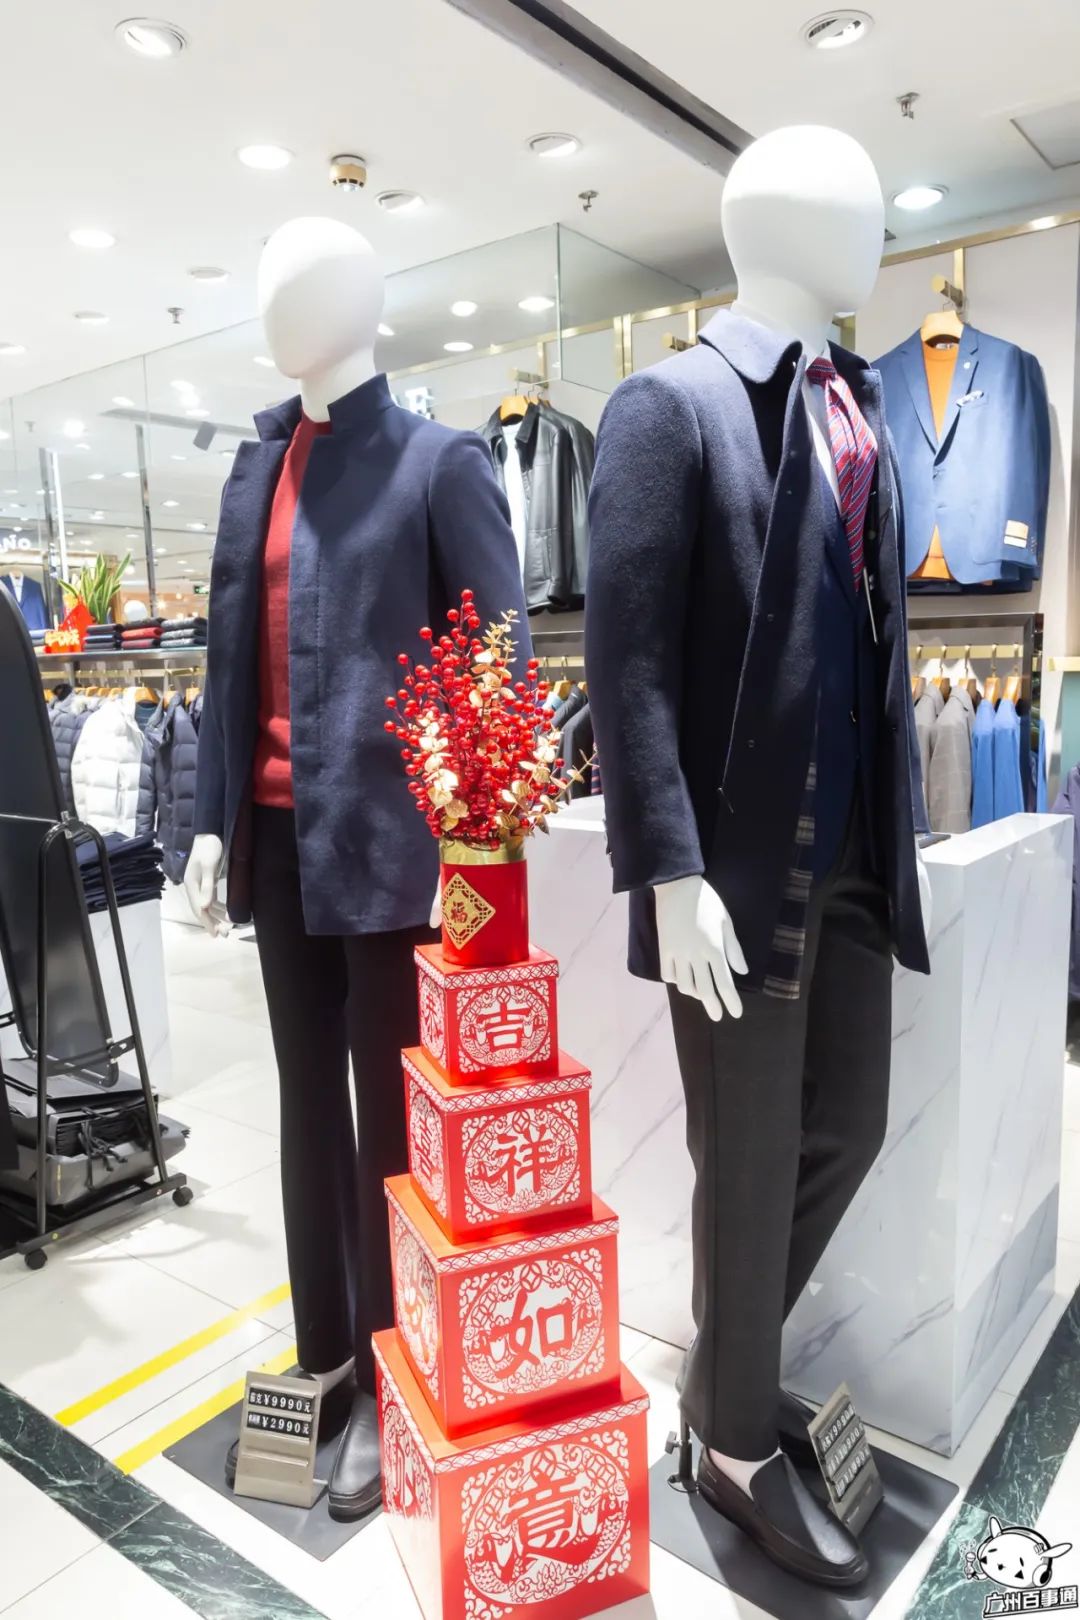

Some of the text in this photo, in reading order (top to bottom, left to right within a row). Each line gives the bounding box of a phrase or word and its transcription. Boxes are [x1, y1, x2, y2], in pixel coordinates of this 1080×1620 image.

[477, 1000, 532, 1052] 吉
[484, 1123, 572, 1198] 祥
[488, 1289, 575, 1377] 如
[498, 1471, 602, 1584] 意
